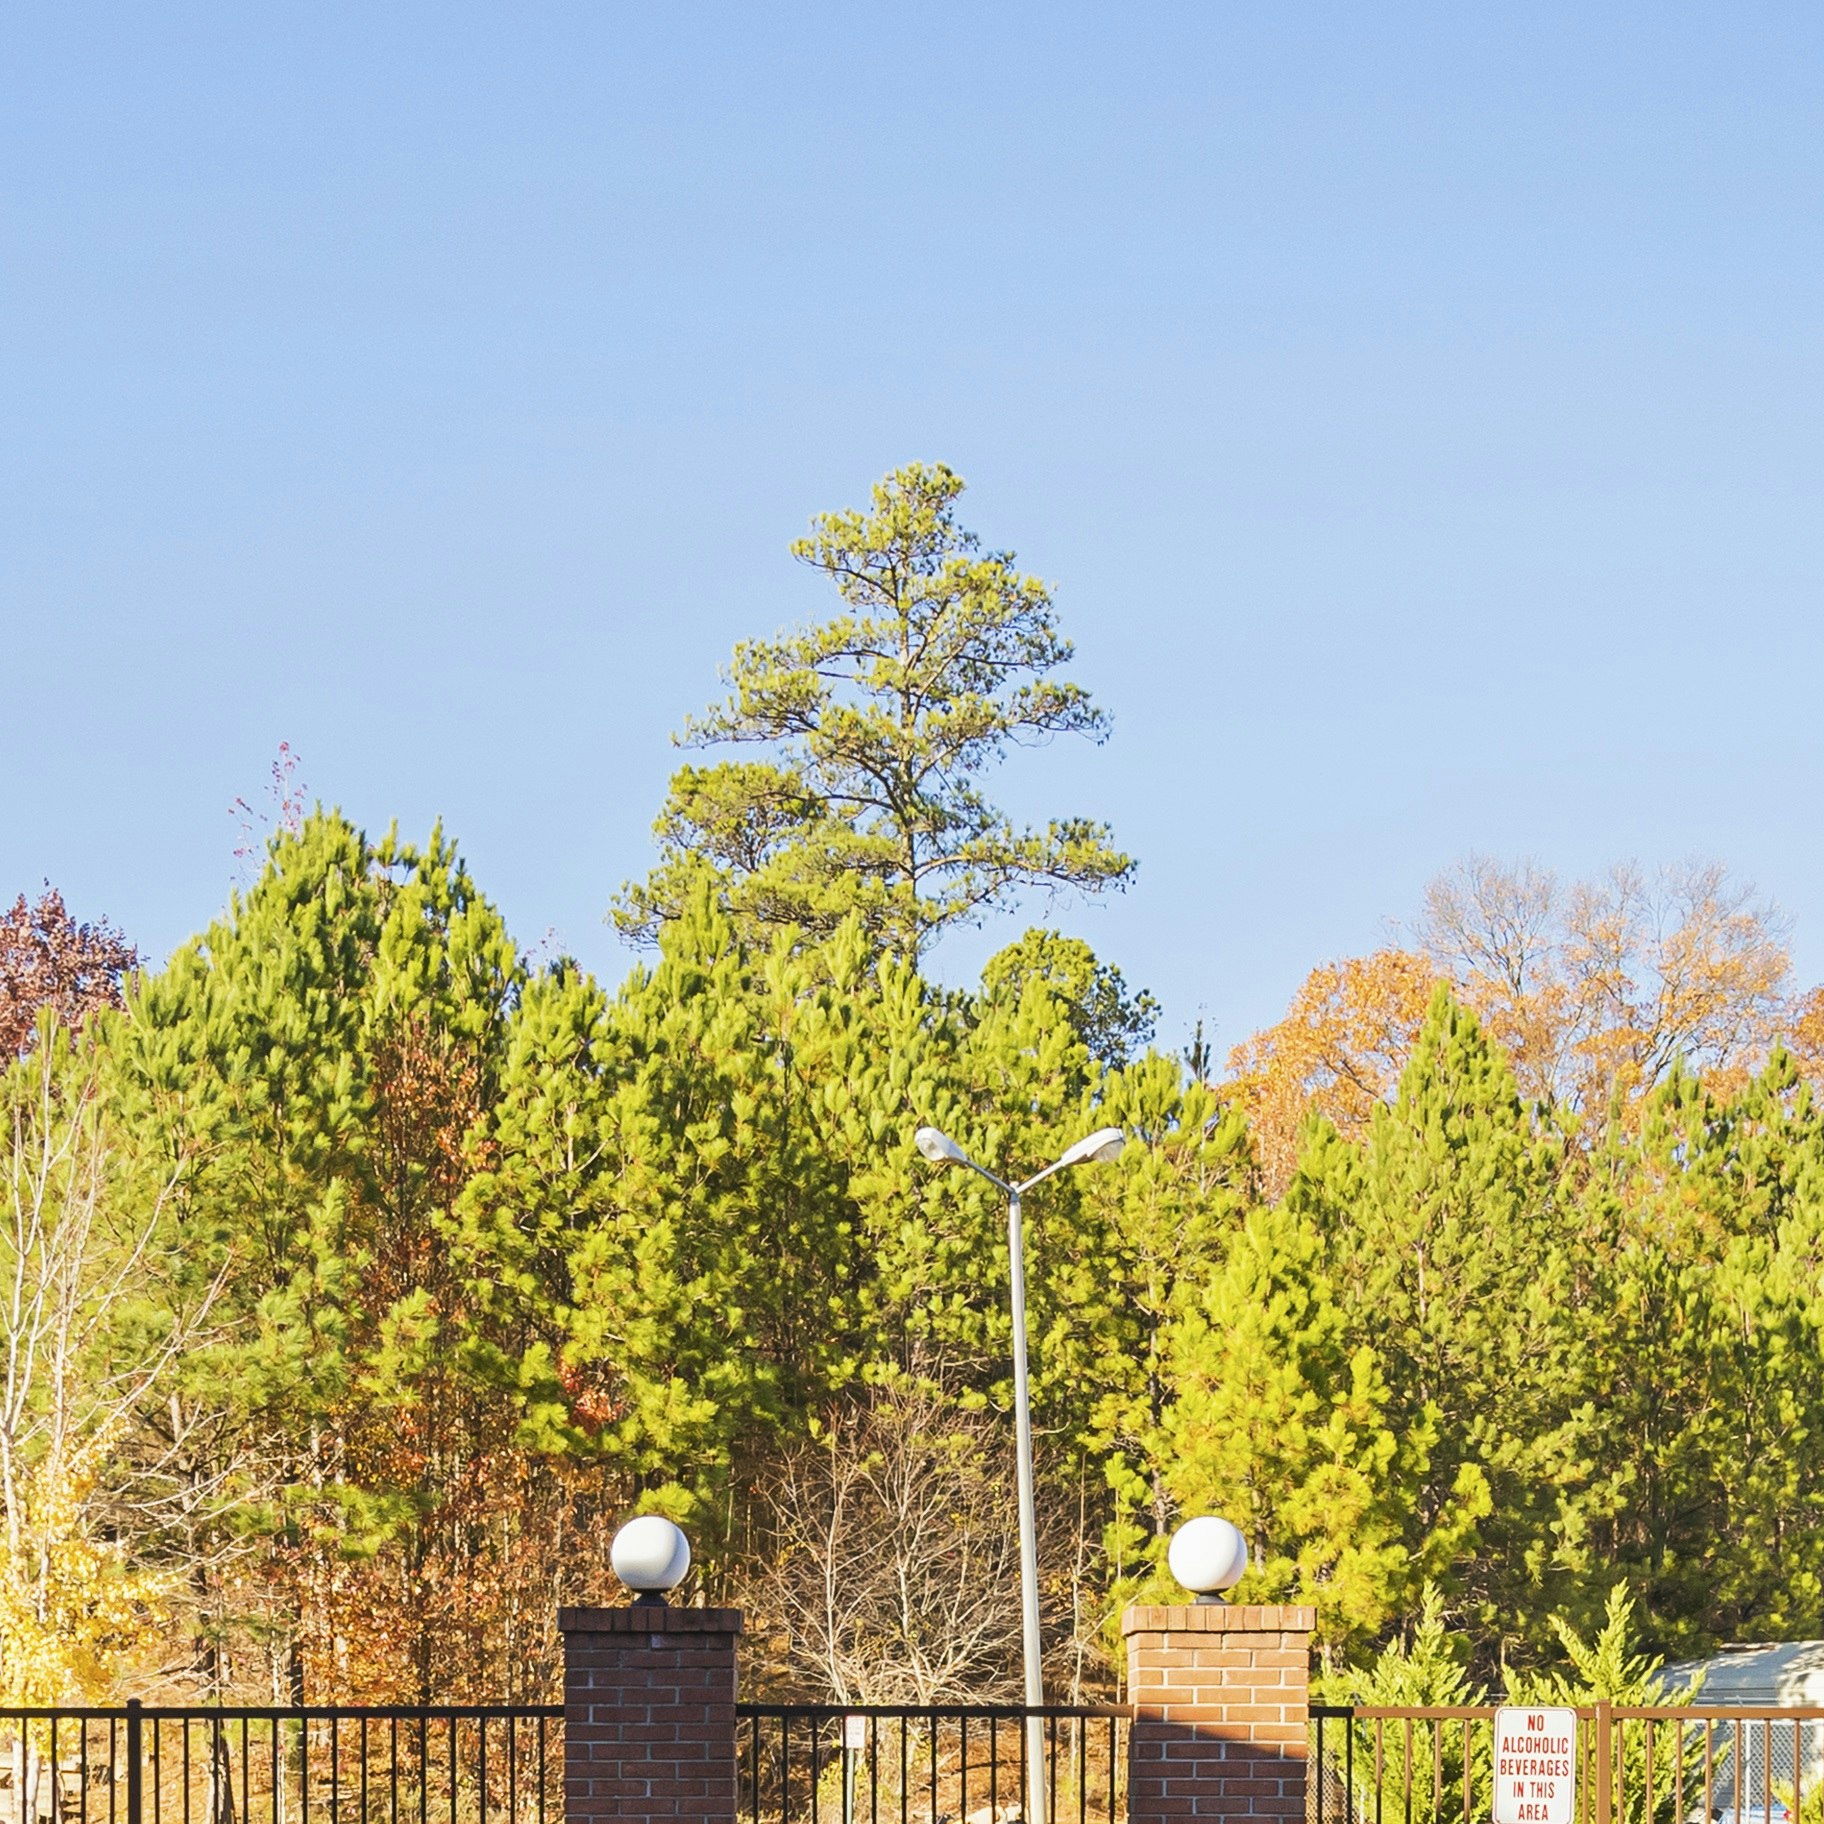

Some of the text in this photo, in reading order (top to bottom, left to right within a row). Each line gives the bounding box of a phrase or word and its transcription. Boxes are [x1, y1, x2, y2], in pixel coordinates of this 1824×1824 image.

[1527, 1714, 1544, 1731] NO
[1502, 1736, 1569, 1754] ALCOHOLIC
[1500, 1759, 1569, 1776] BEVERAGES
[1513, 1782, 1555, 1798] IN THIS
[1518, 1804, 1548, 1820] AREA
